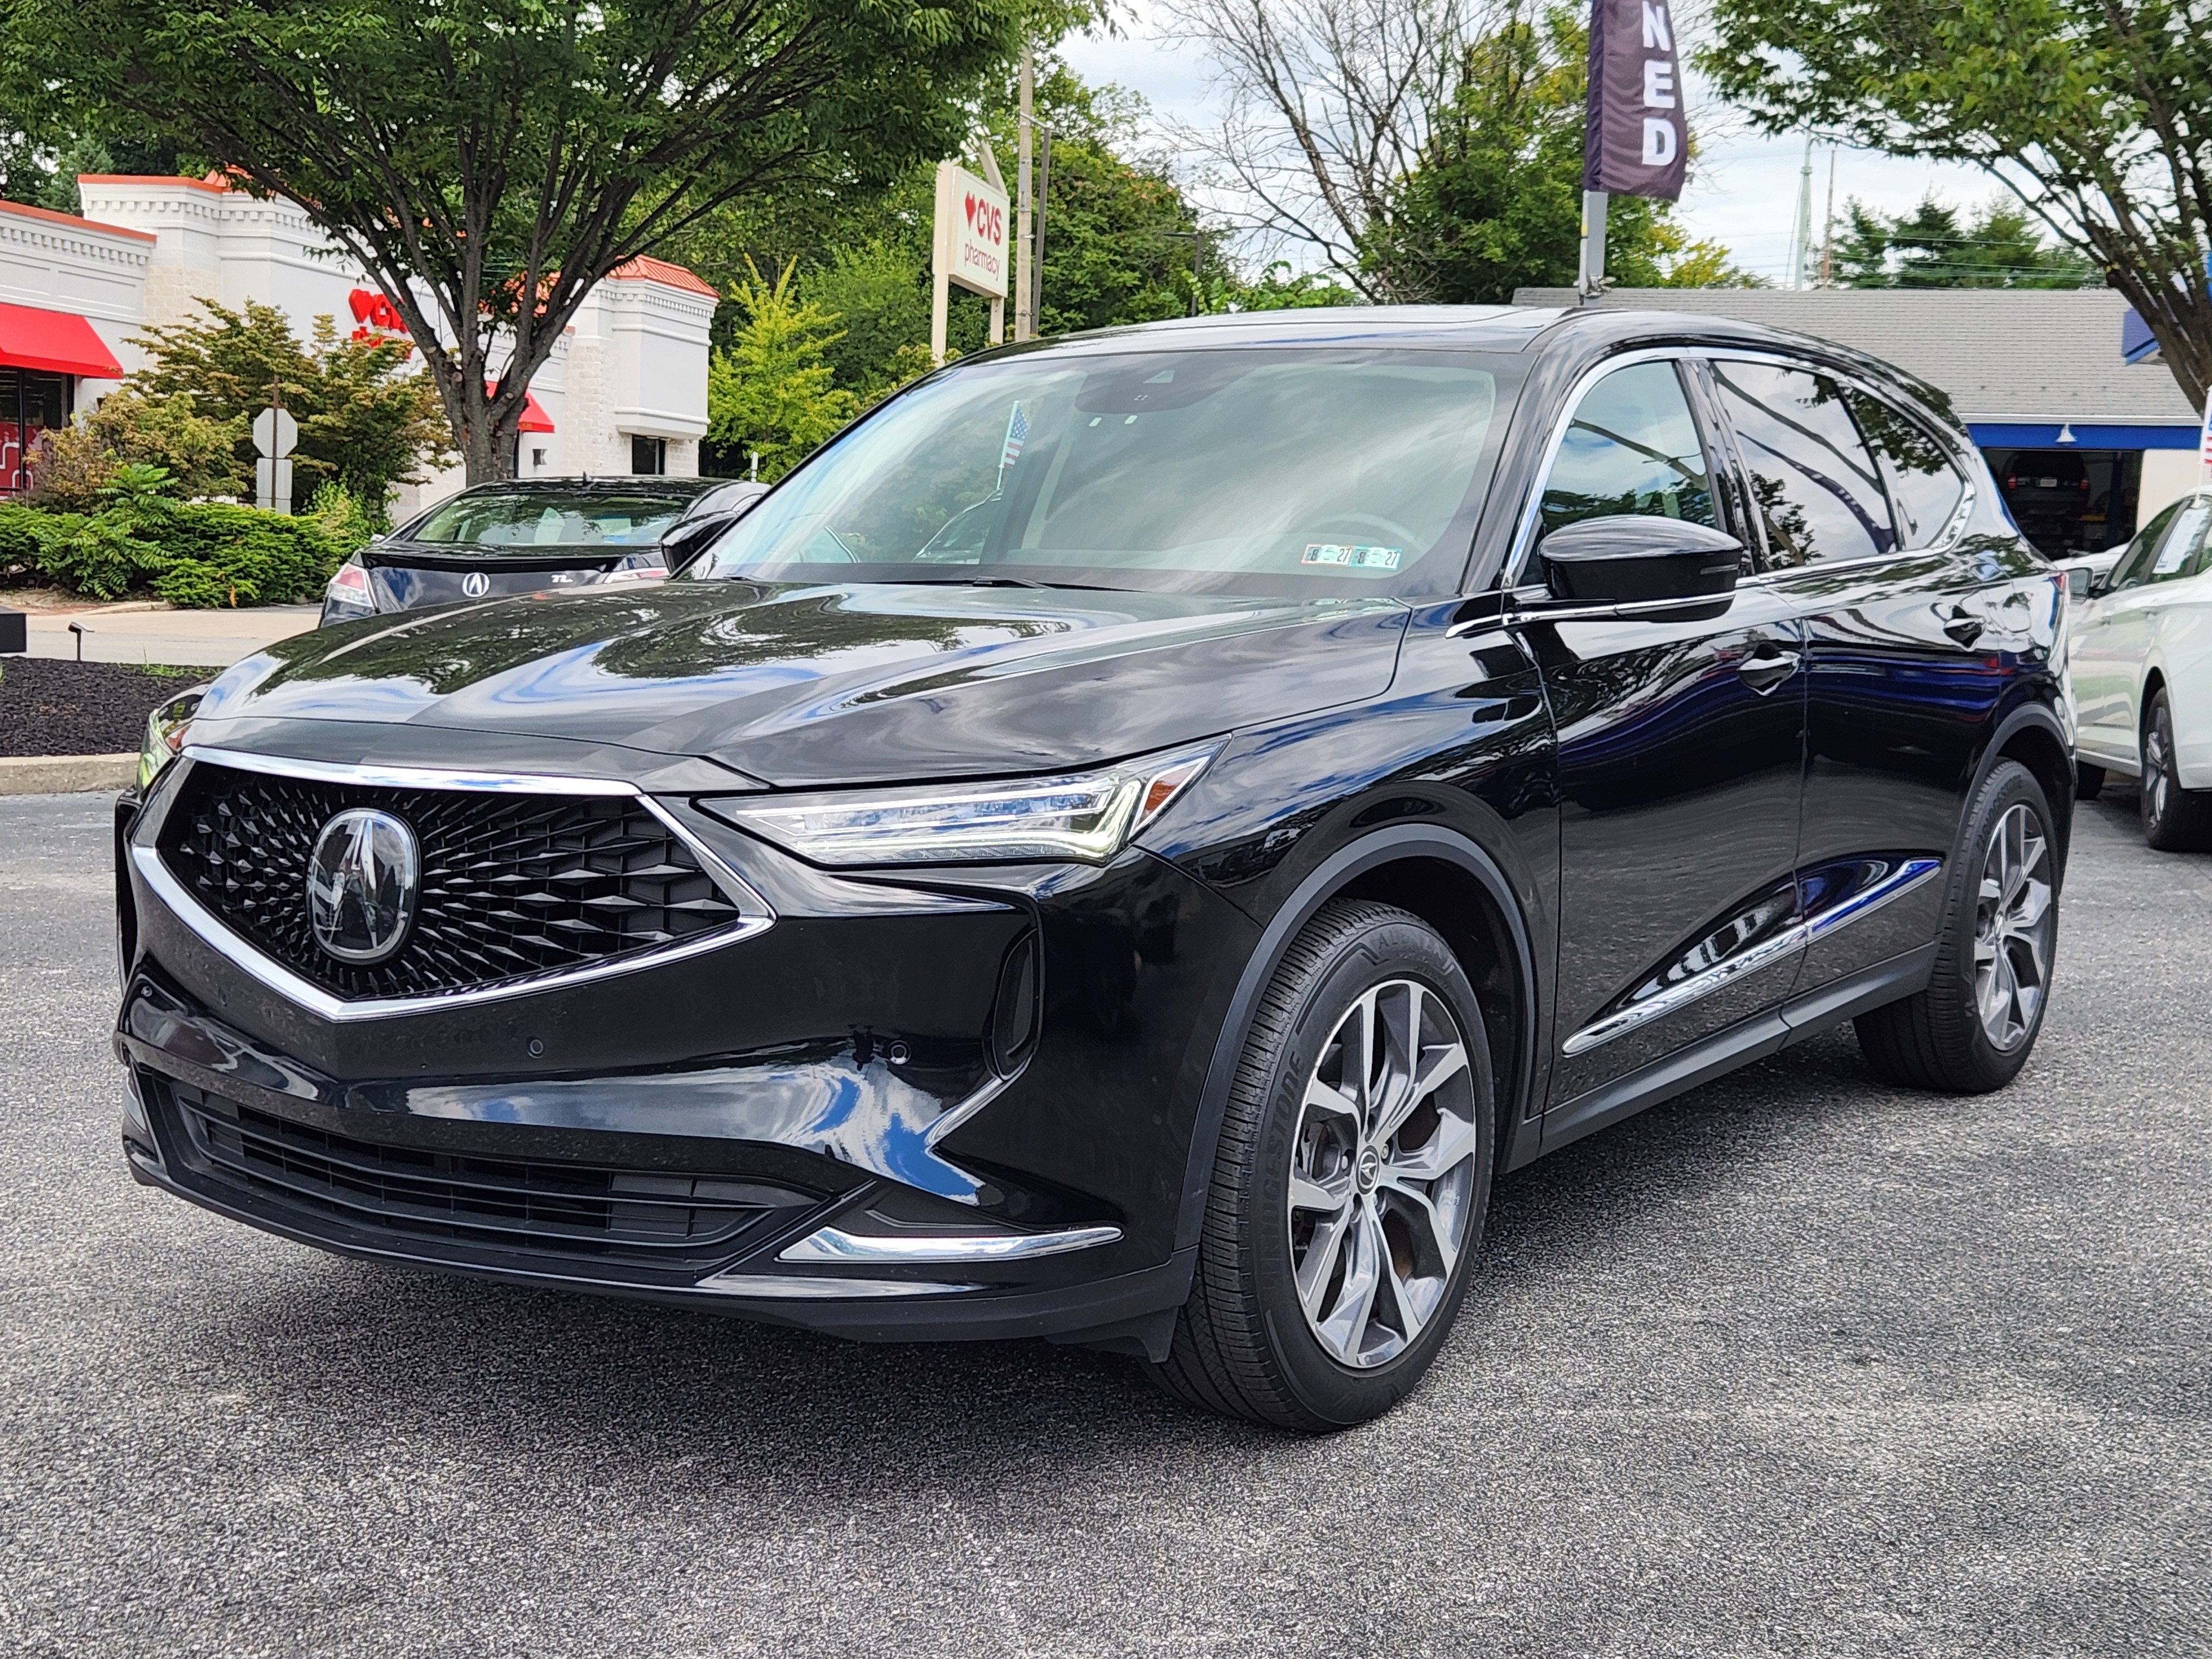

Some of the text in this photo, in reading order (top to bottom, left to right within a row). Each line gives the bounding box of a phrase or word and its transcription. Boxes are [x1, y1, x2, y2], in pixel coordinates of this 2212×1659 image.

[1642, 1, 1677, 166] NED
[977, 199, 1002, 246] CVS
[964, 238, 1000, 281] pharmacy
[1337, 548, 1350, 563] 27
[1385, 551, 1398, 566] 27
